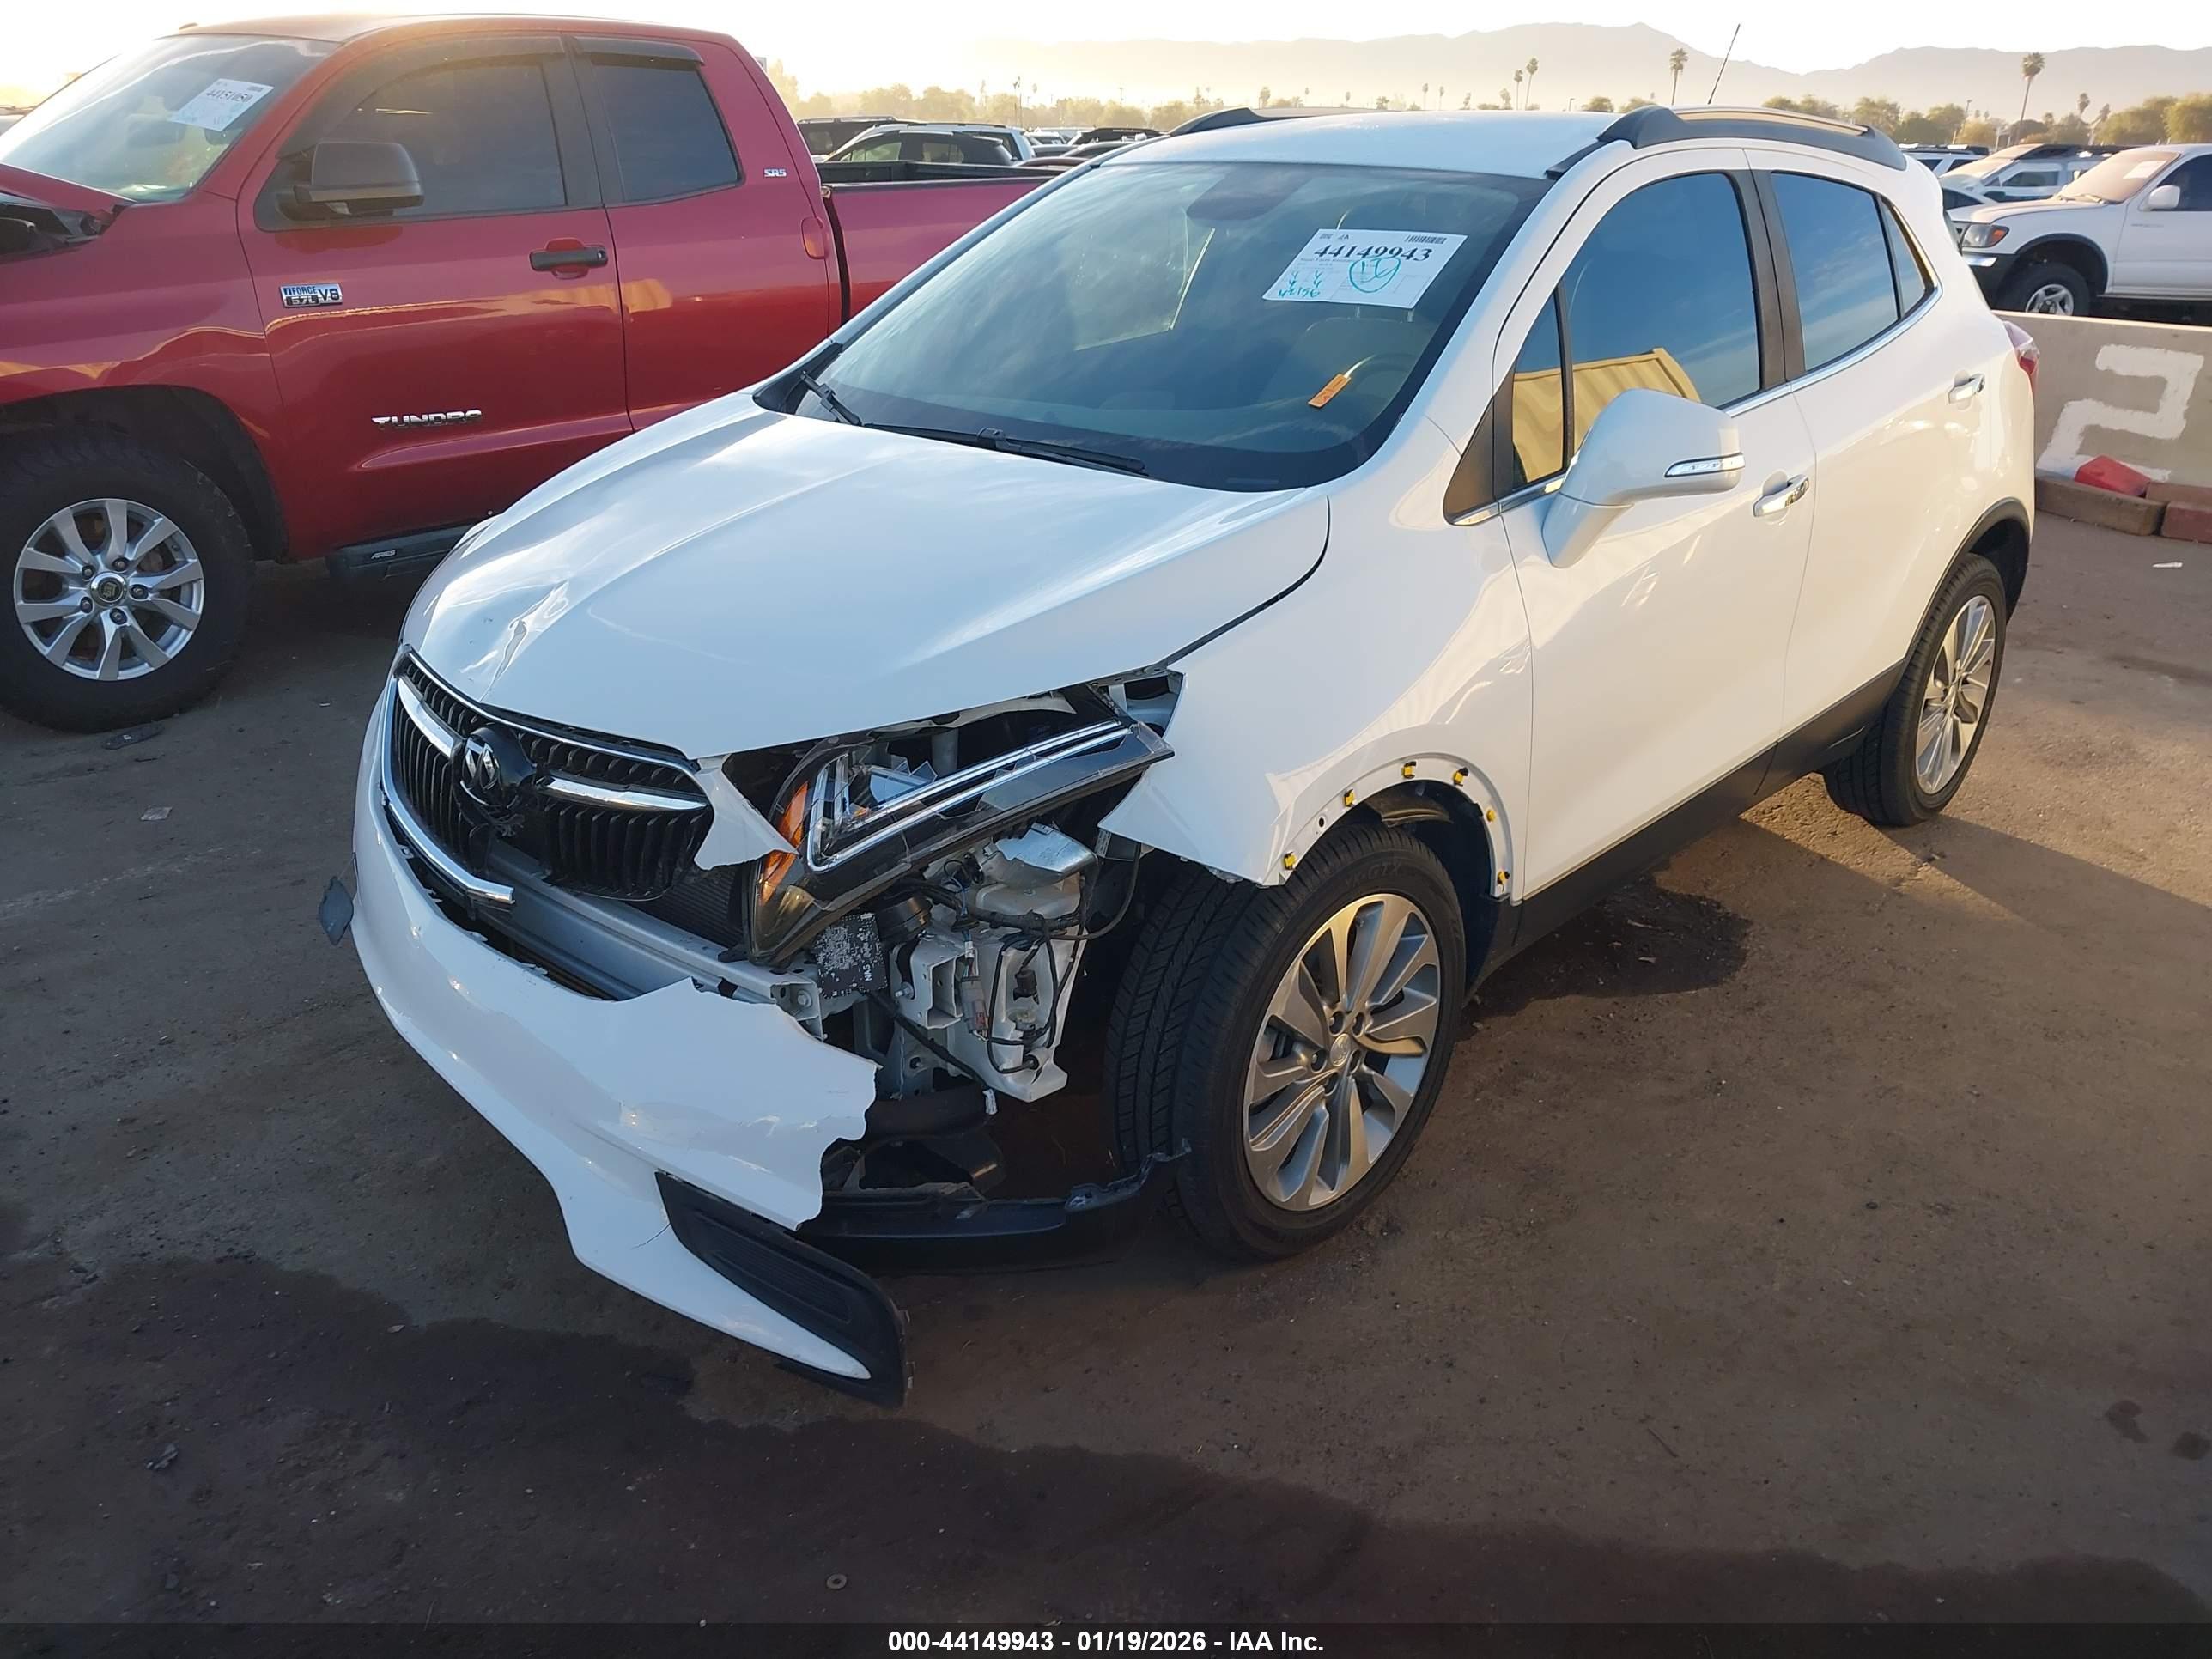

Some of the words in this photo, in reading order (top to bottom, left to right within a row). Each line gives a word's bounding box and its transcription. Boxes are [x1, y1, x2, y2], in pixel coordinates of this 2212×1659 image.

[1314, 245, 1433, 261] 44149943
[318, 288, 340, 301] V8
[371, 409, 482, 430] TUNDRA
[2036, 344, 2204, 483] 2
